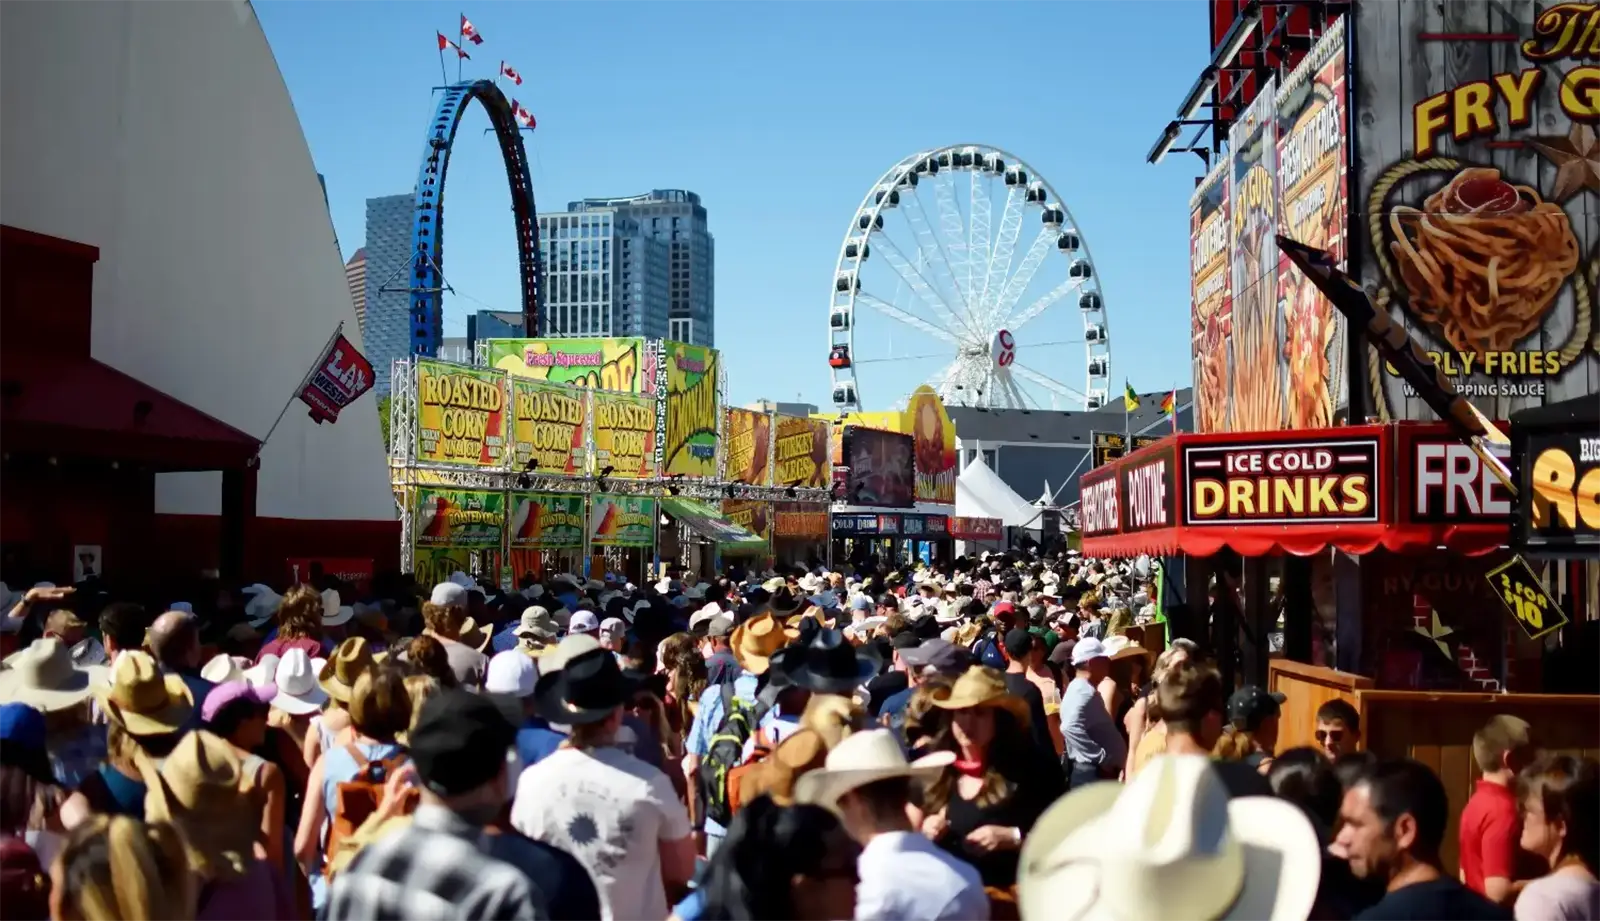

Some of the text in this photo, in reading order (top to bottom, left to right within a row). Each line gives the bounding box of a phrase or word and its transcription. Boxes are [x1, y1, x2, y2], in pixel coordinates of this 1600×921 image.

[1413, 68, 1544, 157] FRY
[1303, 115, 1317, 173] CUT
[1317, 94, 1340, 155] FRIES
[1248, 166, 1274, 217] GUYS
[526, 350, 602, 370] Fresh Squeezed
[1485, 351, 1560, 374] FRIES
[424, 374, 502, 412] ROASTED
[655, 337, 669, 463] LEMONADE
[1501, 384, 1545, 396] SAUCE
[519, 390, 584, 425] ROASTED
[598, 403, 655, 432] ROASTED
[441, 409, 487, 439] CORN
[533, 423, 574, 451] CORN
[611, 431, 646, 457] CORN
[779, 431, 815, 461] TURKEY
[784, 456, 812, 481] LEGS
[1227, 451, 1333, 473] ICE COLD
[1128, 460, 1167, 527] POUTINE
[1194, 475, 1369, 515] DRINKS
[833, 519, 854, 530] COLD
[1501, 573, 1548, 610] 2 FOR
[1504, 591, 1544, 630] $10
